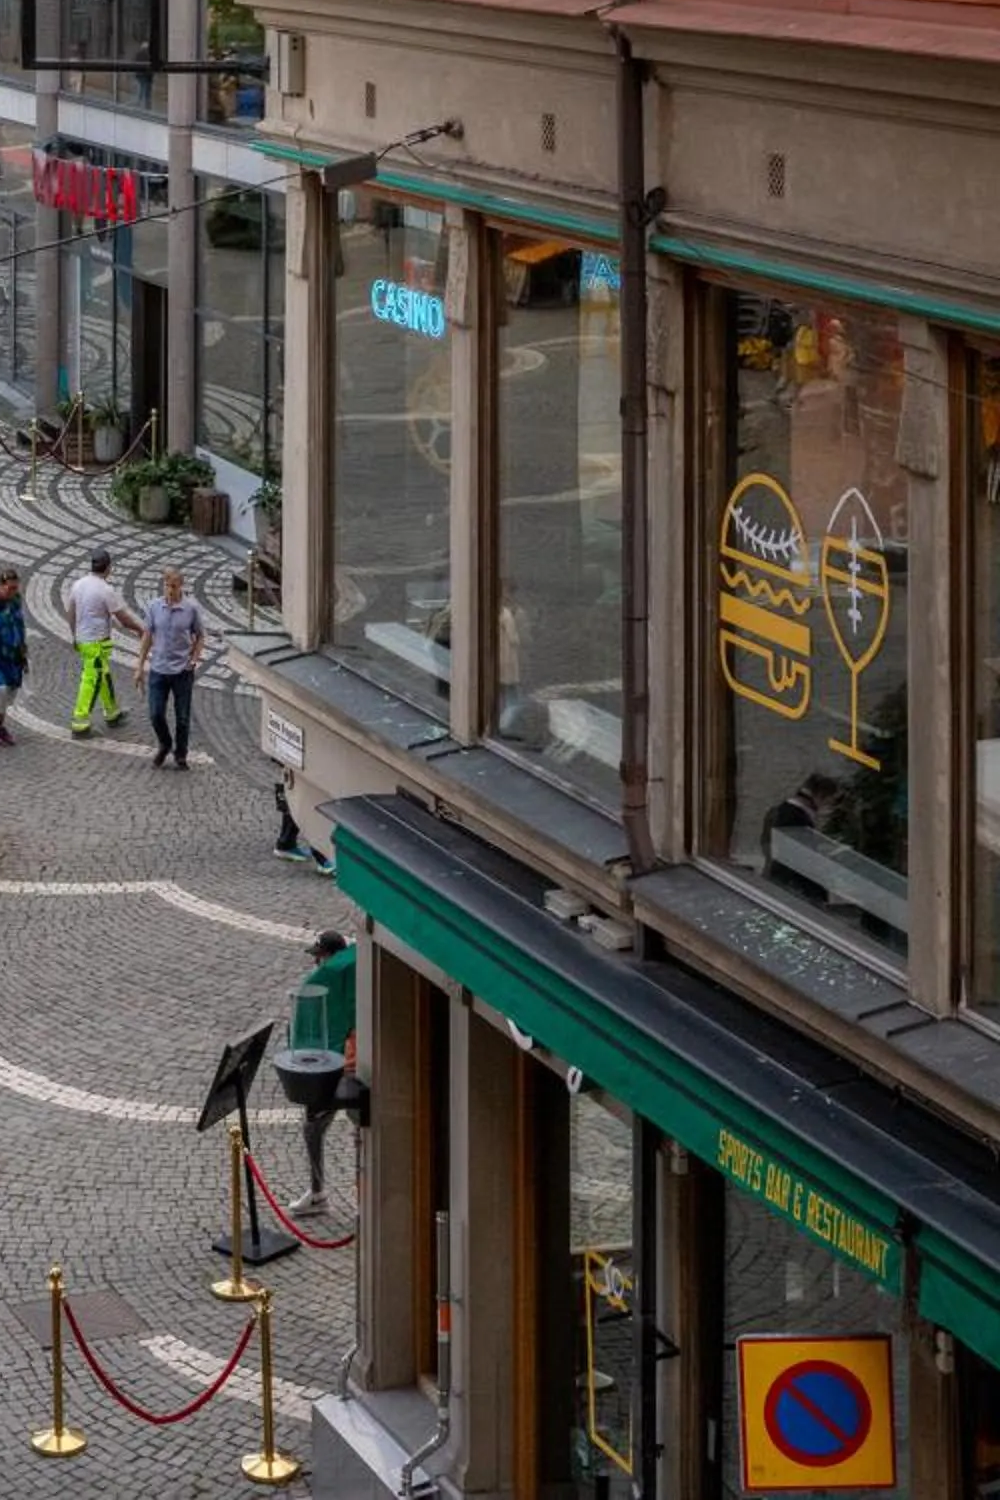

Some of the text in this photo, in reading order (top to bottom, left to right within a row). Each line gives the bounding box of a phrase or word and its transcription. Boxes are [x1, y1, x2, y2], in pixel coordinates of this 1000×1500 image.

[371, 280, 445, 339] CASINO
[718, 1129, 763, 1191] SPORTS
[765, 1163, 791, 1212] BAR
[806, 1190, 888, 1279] RESTAURANT
